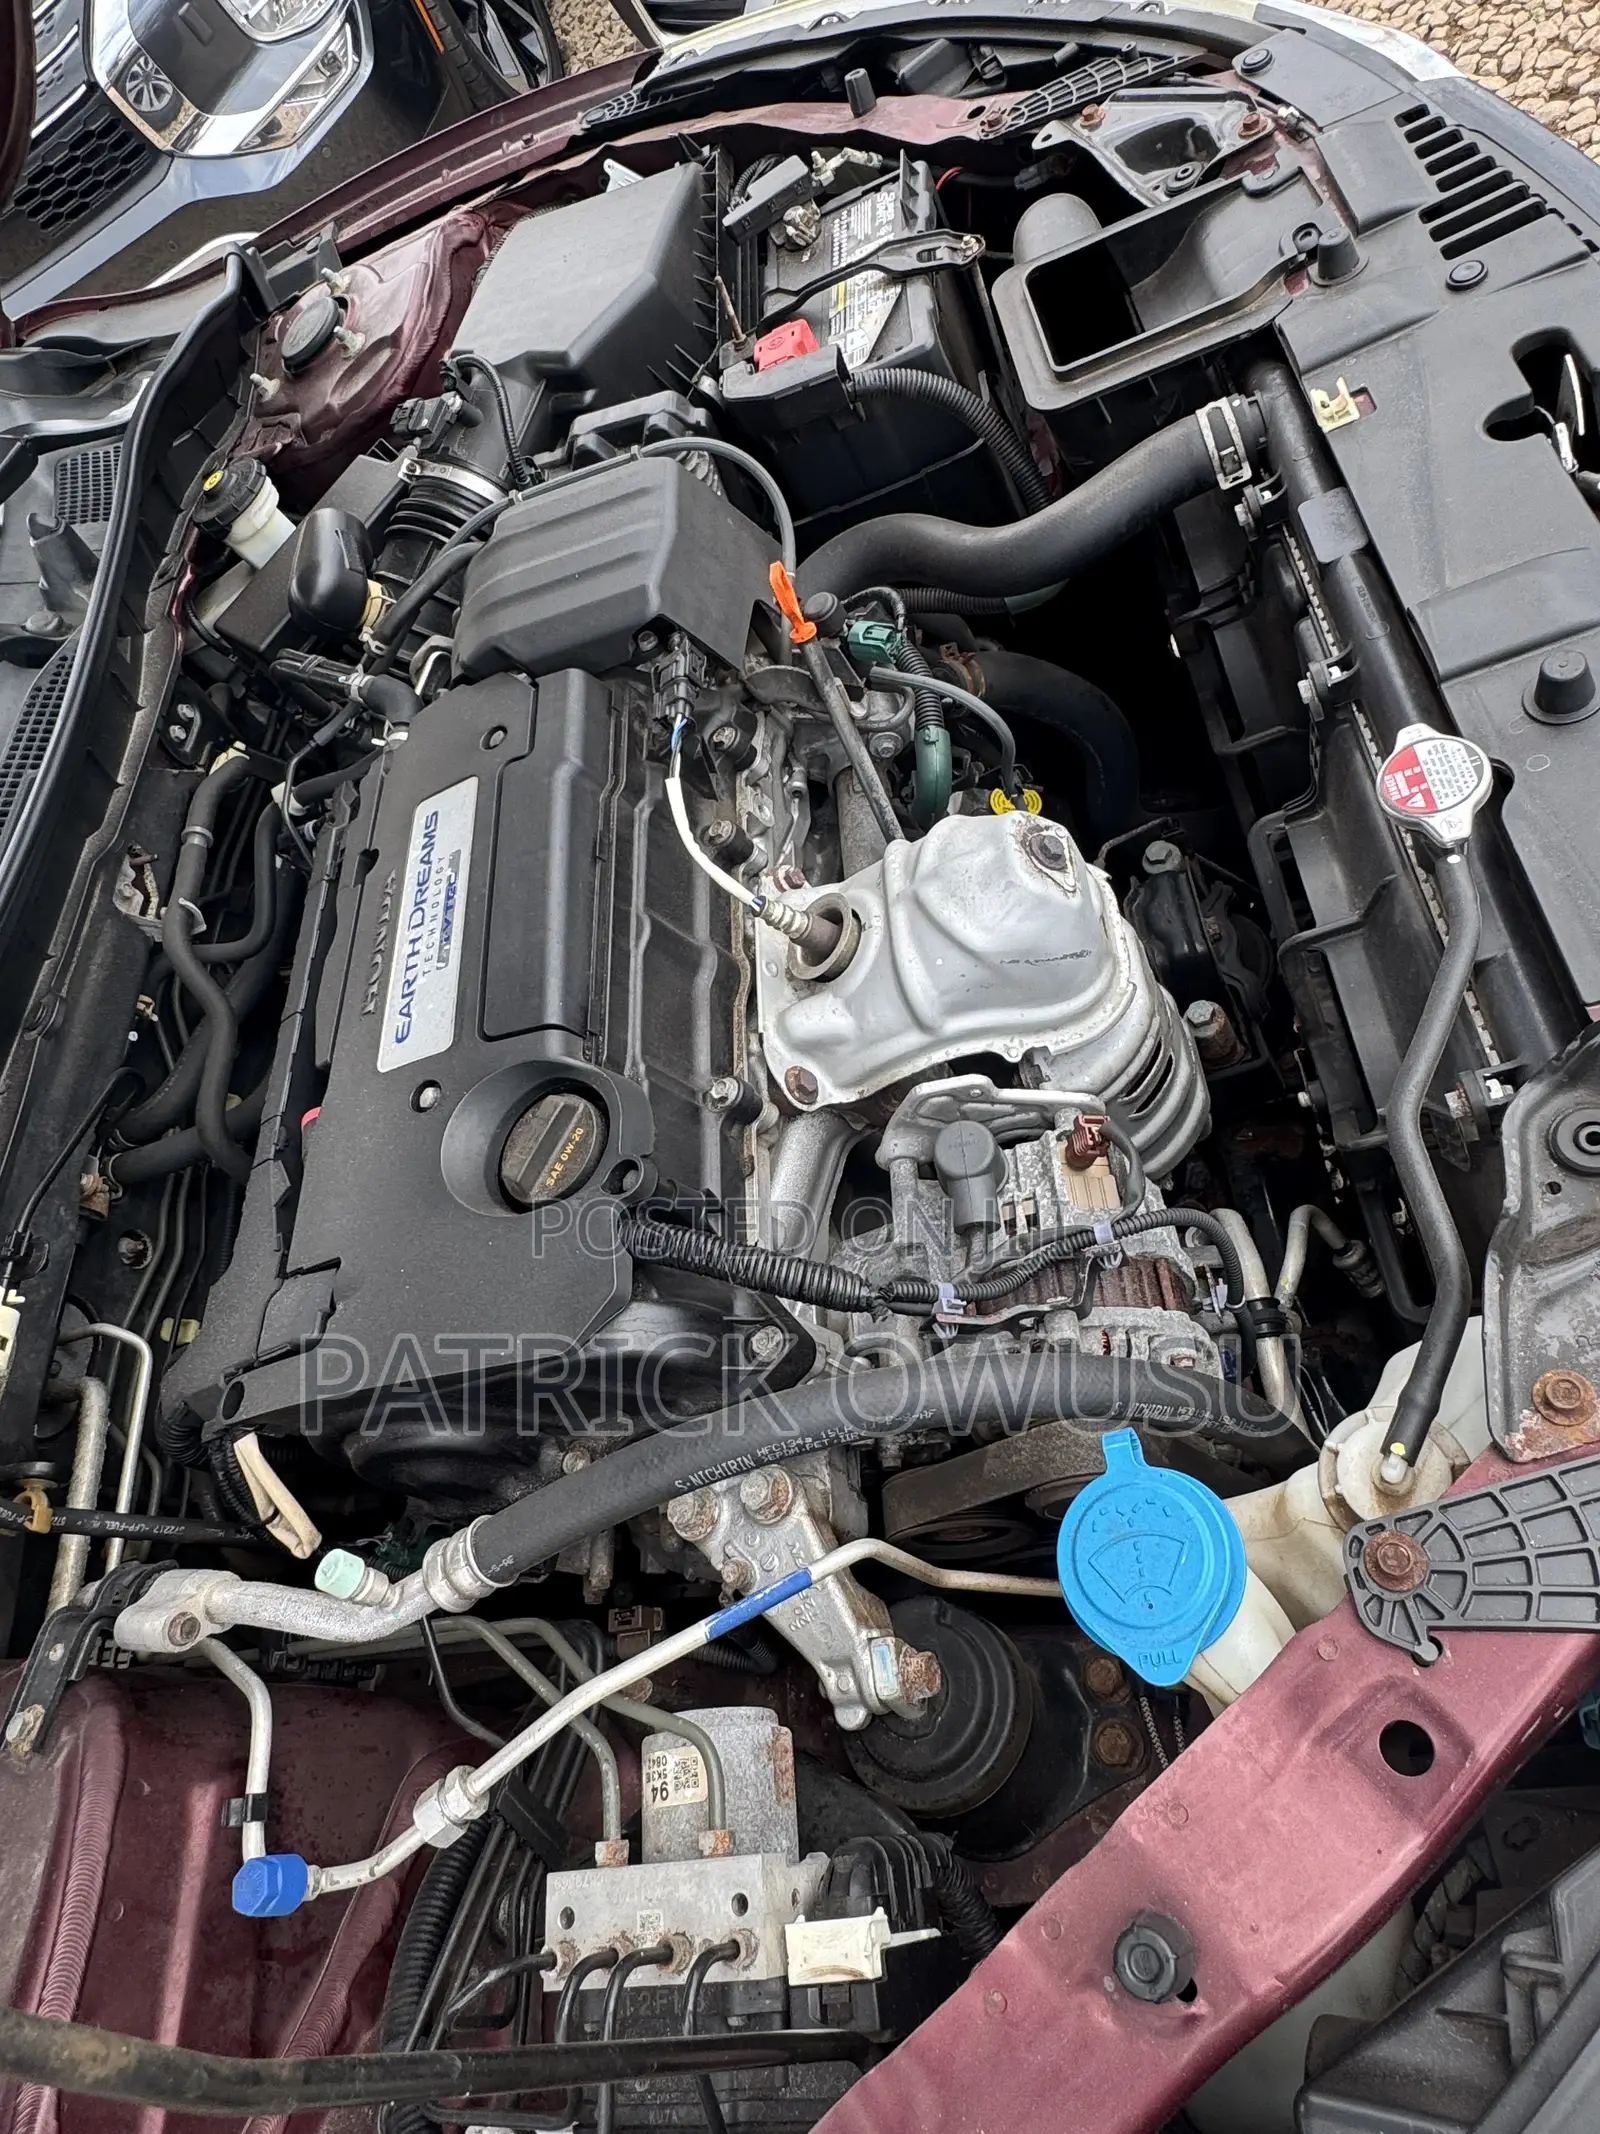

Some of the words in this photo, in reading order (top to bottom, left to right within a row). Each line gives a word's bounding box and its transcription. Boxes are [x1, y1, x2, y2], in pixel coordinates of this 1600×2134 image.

[408, 810, 440, 933] DREAMS
[422, 855, 445, 977] TECHNOLOGY
[361, 867, 396, 1020] HONDA
[395, 931, 425, 1044] EARTH
[545, 1162, 564, 1186] SAE
[560, 1127, 584, 1161] 0W-20
[1137, 1649, 1183, 1670] PULL
[650, 1780, 669, 1804] 94
